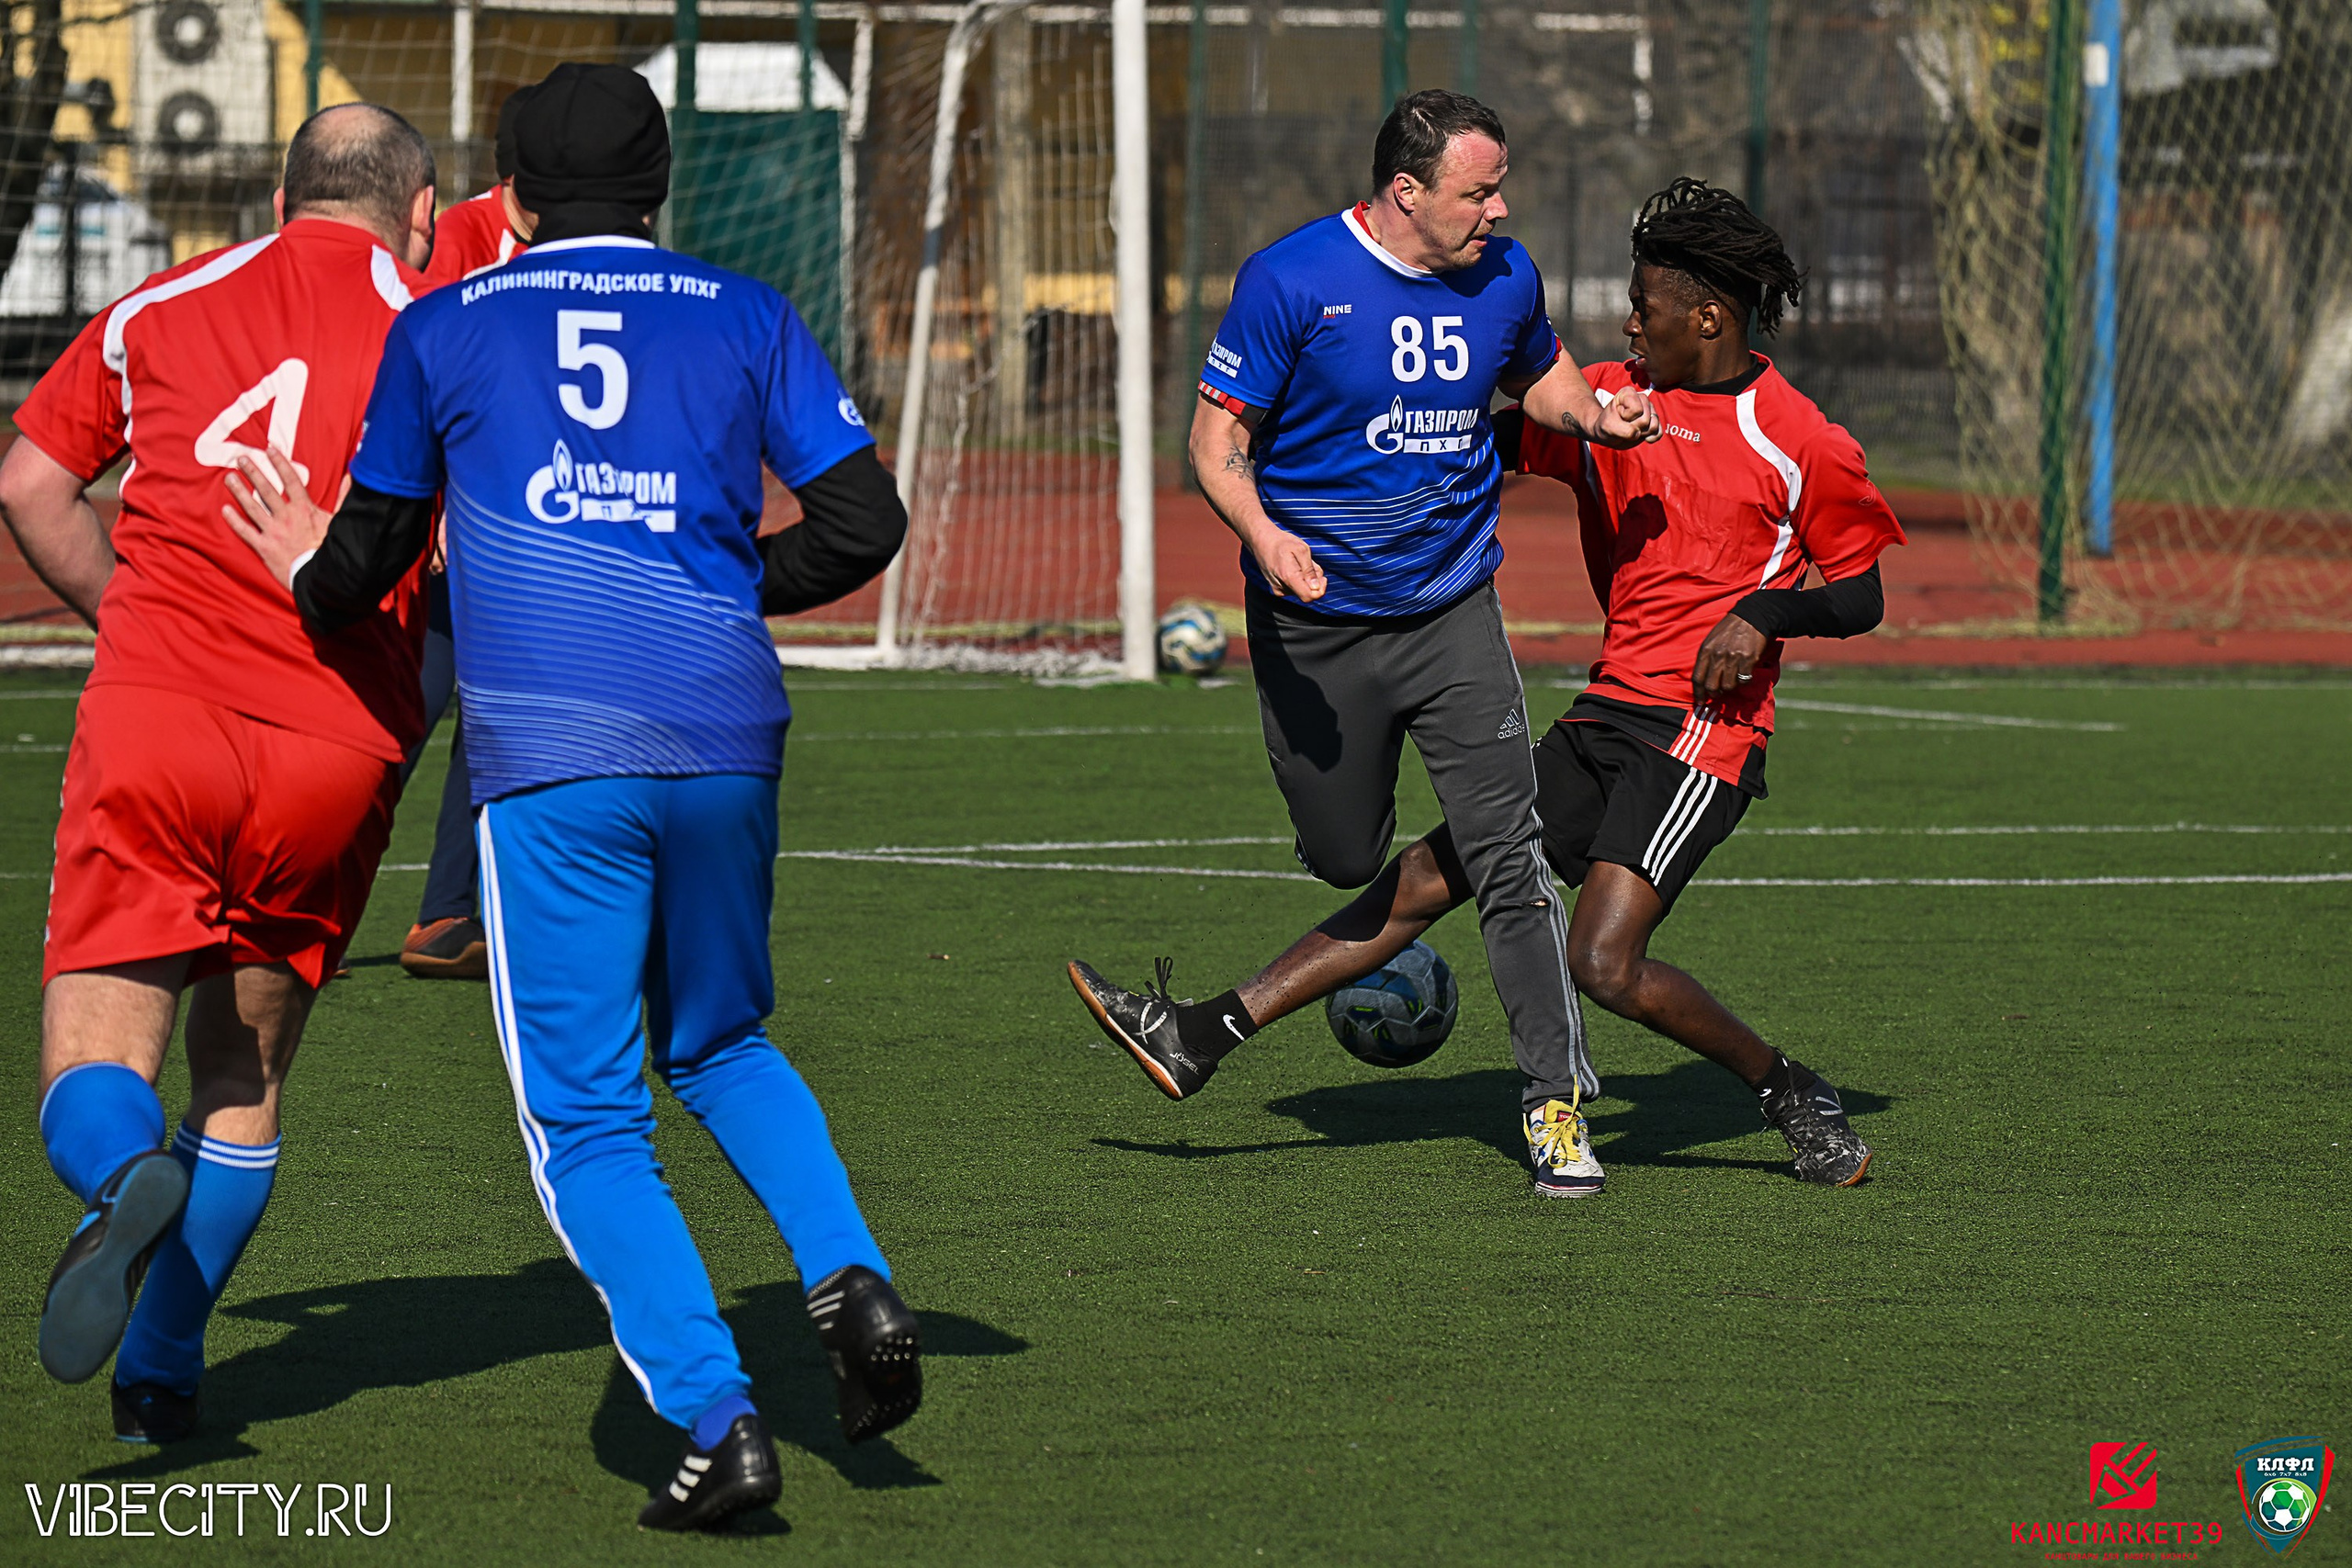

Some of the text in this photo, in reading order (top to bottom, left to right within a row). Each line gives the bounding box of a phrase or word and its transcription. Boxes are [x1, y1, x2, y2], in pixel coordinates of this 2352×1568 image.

[460, 270, 722, 306] КАЛИНИНГРАДСКОЕ УПХГ
[1323, 304, 1352, 316] NINE
[557, 309, 629, 431] 5
[1390, 315, 1470, 383] 85
[194, 357, 311, 517] 4
[1405, 408, 1479, 434] ГАЗПРОМ
